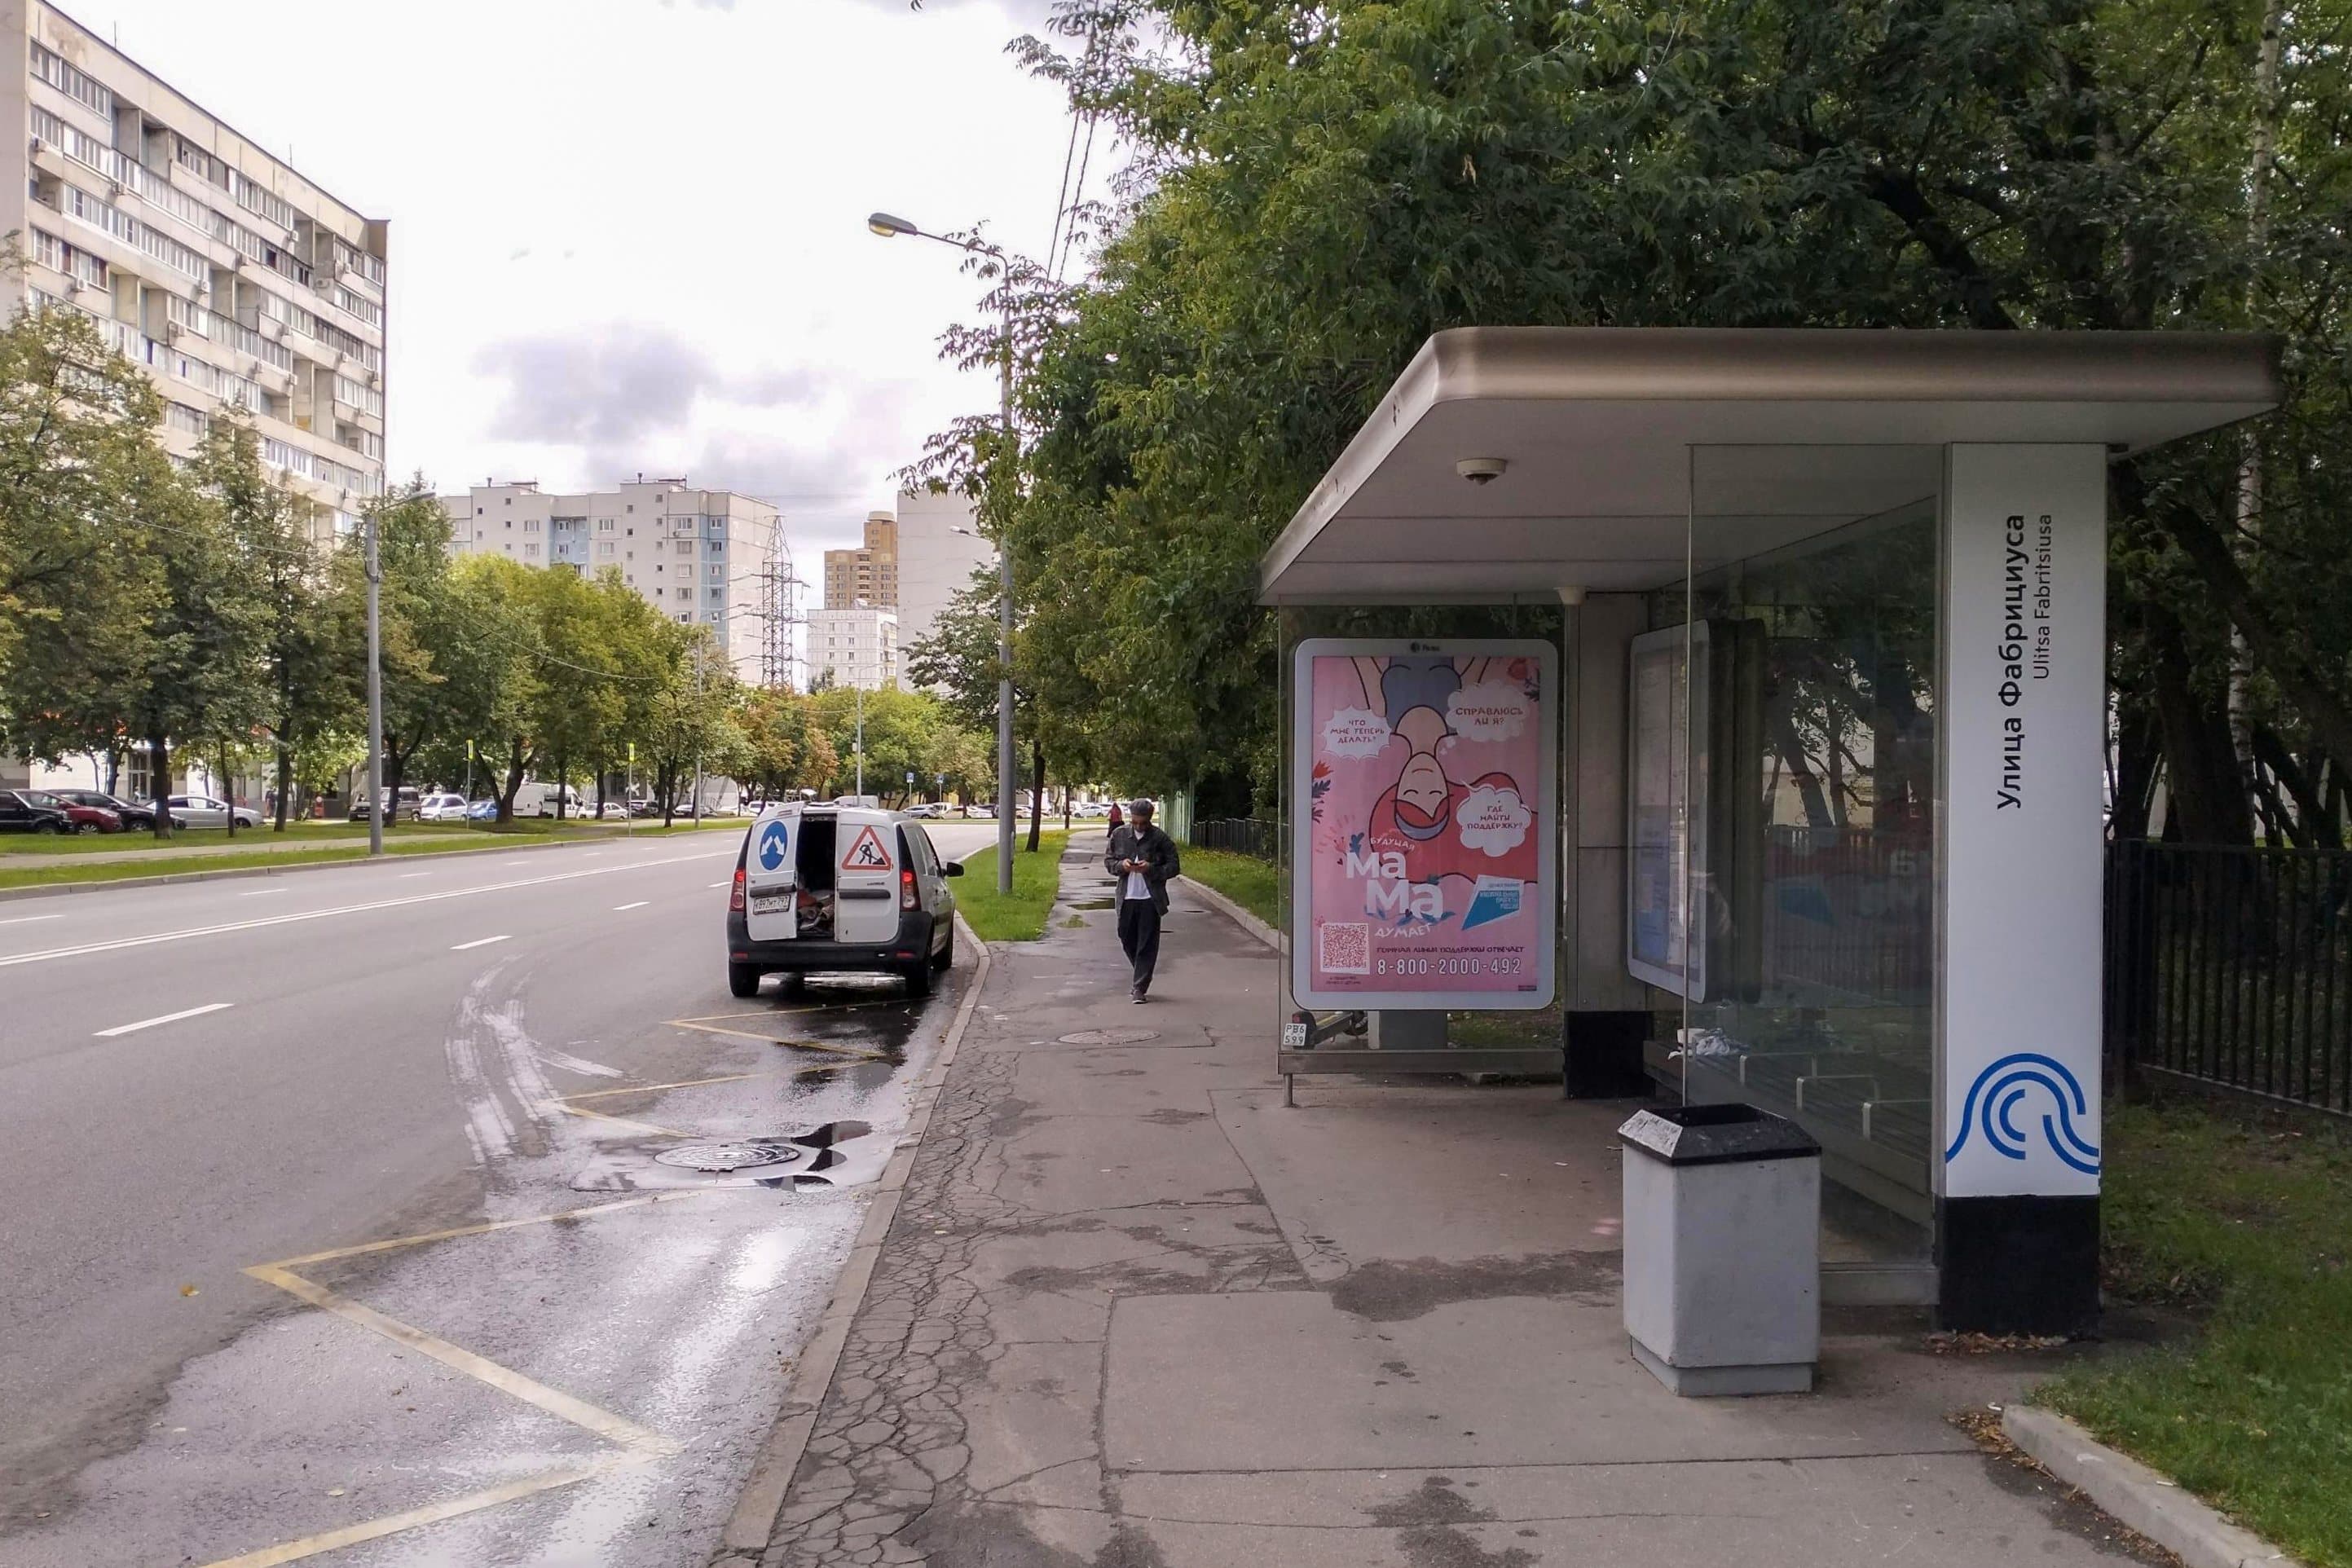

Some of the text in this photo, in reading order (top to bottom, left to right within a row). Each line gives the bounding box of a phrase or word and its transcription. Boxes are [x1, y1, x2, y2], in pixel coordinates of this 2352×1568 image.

[2033, 514, 2052, 679] Ulitsa Fabritsiusa
[1997, 514, 2029, 810] Улица Фабрициуса
[1456, 707, 1524, 716] СПРАВЛЮСЬ
[1473, 717, 1489, 725] ЛИ
[1375, 923, 1431, 938] ДУМАЕТ
[1377, 958, 1522, 976] 8-800-2000-492
